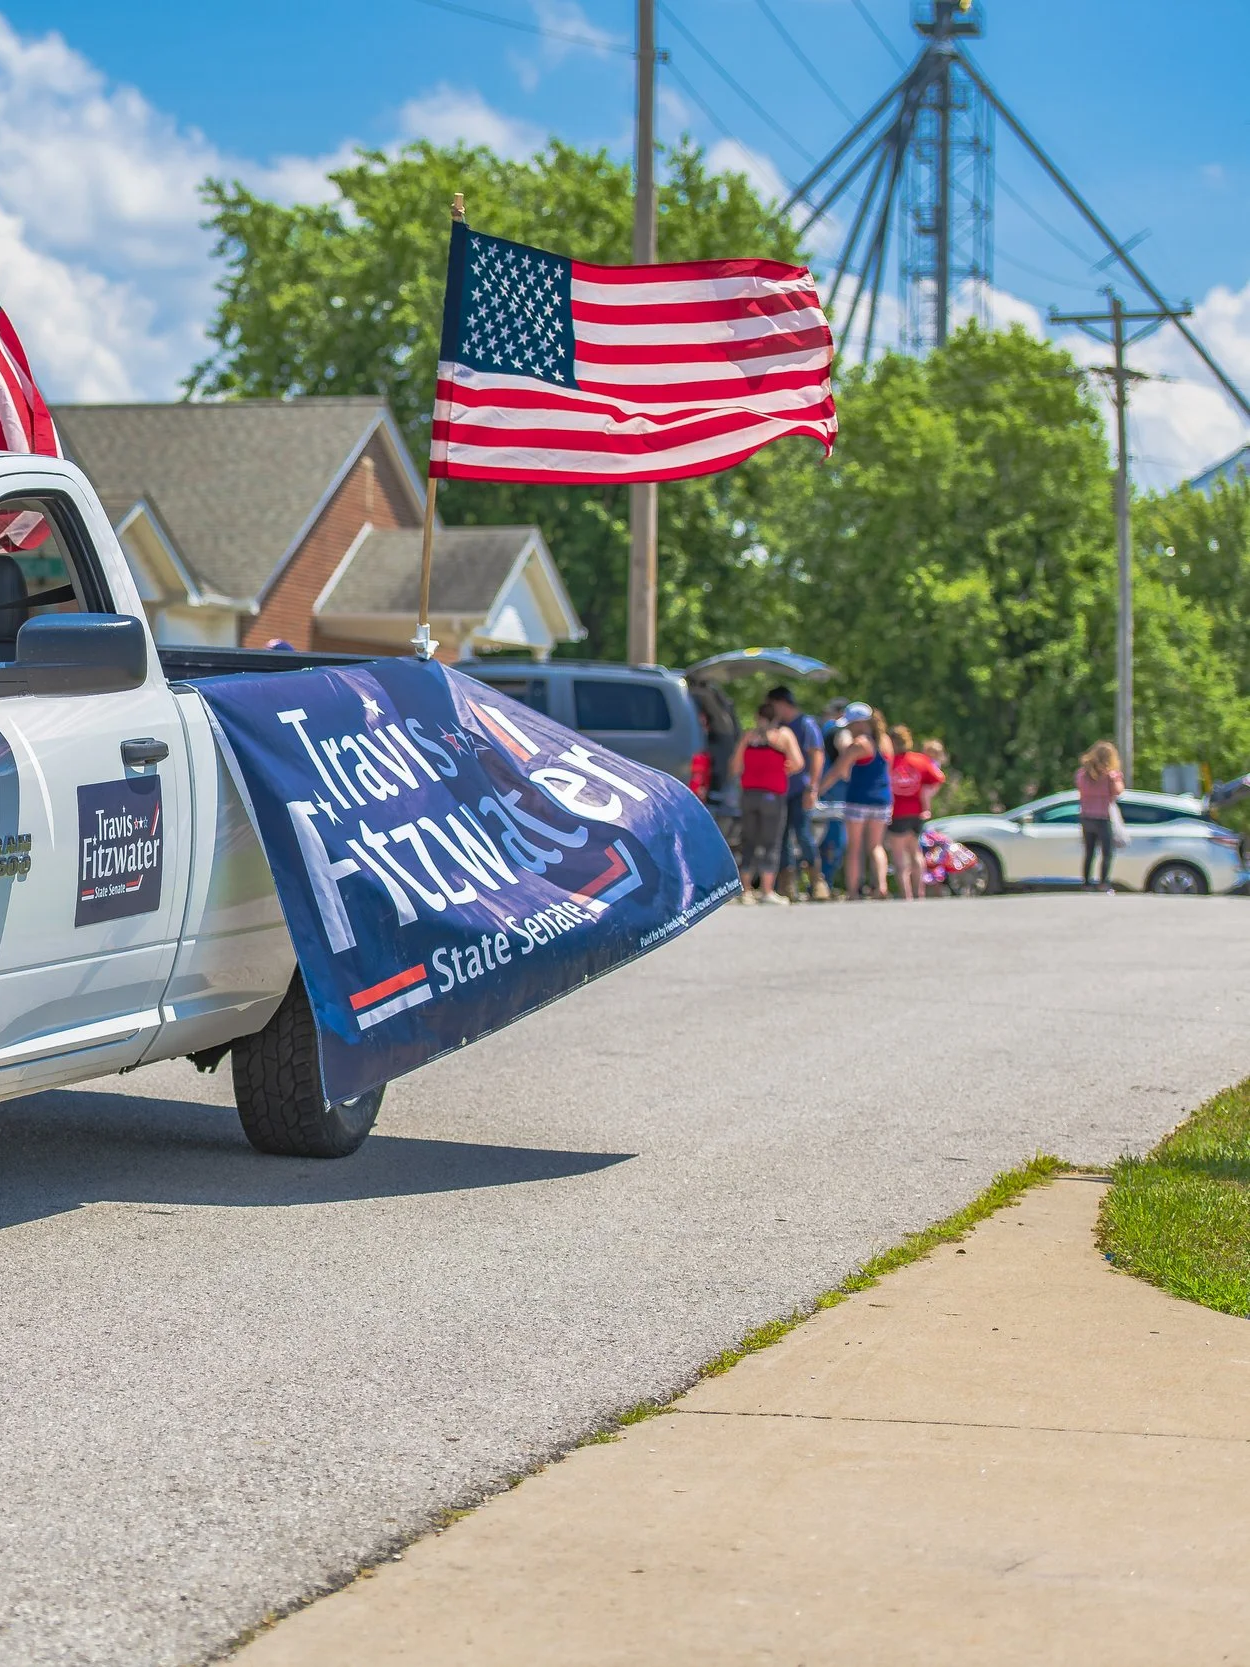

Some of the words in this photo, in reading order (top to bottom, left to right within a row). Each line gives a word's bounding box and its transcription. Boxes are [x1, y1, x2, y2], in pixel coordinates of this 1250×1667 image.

[276, 697, 458, 810] Travis
[95, 806, 133, 841] Travis
[285, 745, 649, 954] Fitzwater
[83, 837, 160, 881] Fitzwater
[95, 886, 109, 899] State
[109, 883, 126, 896] Senate
[432, 933, 513, 993] State
[506, 898, 593, 955] Senate
